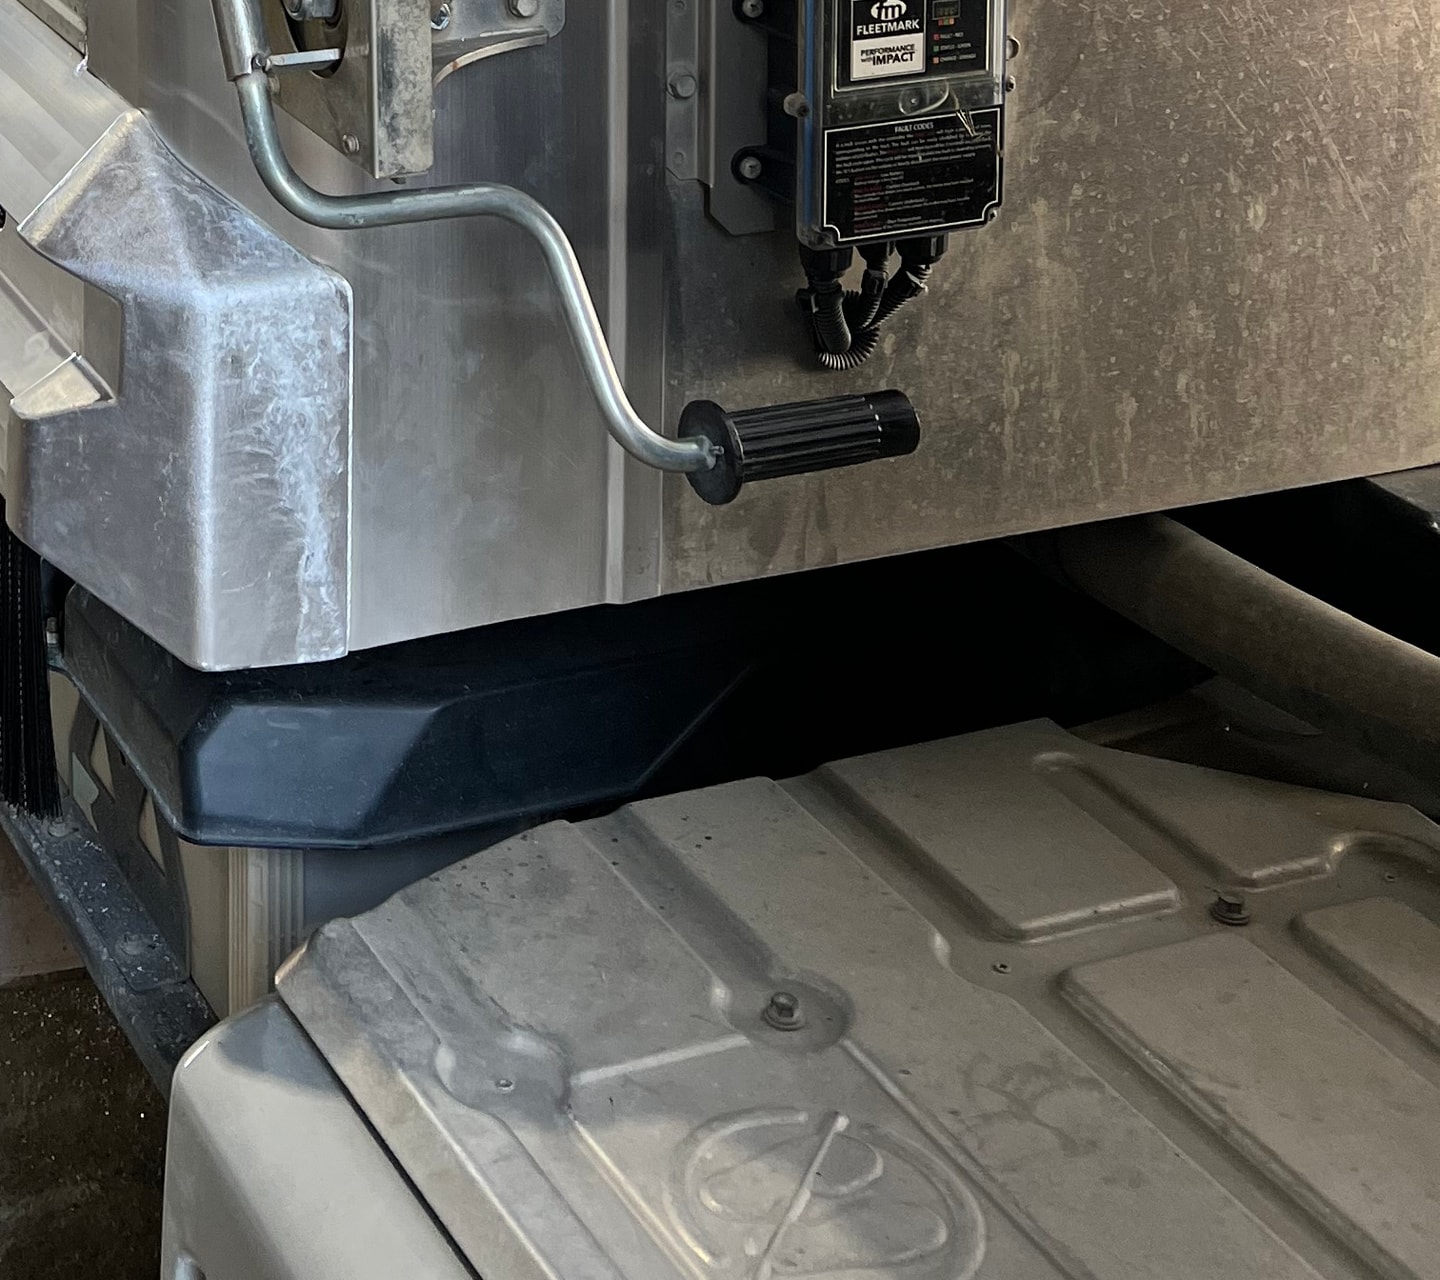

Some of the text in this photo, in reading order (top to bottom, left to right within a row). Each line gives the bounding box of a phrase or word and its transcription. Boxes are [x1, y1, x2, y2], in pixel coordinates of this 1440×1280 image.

[857, 19, 920, 36] FLEETMARK
[861, 44, 915, 56] PERFORMANCE
[872, 51, 915, 65] IMPACT
[913, 122, 934, 130] CODES
